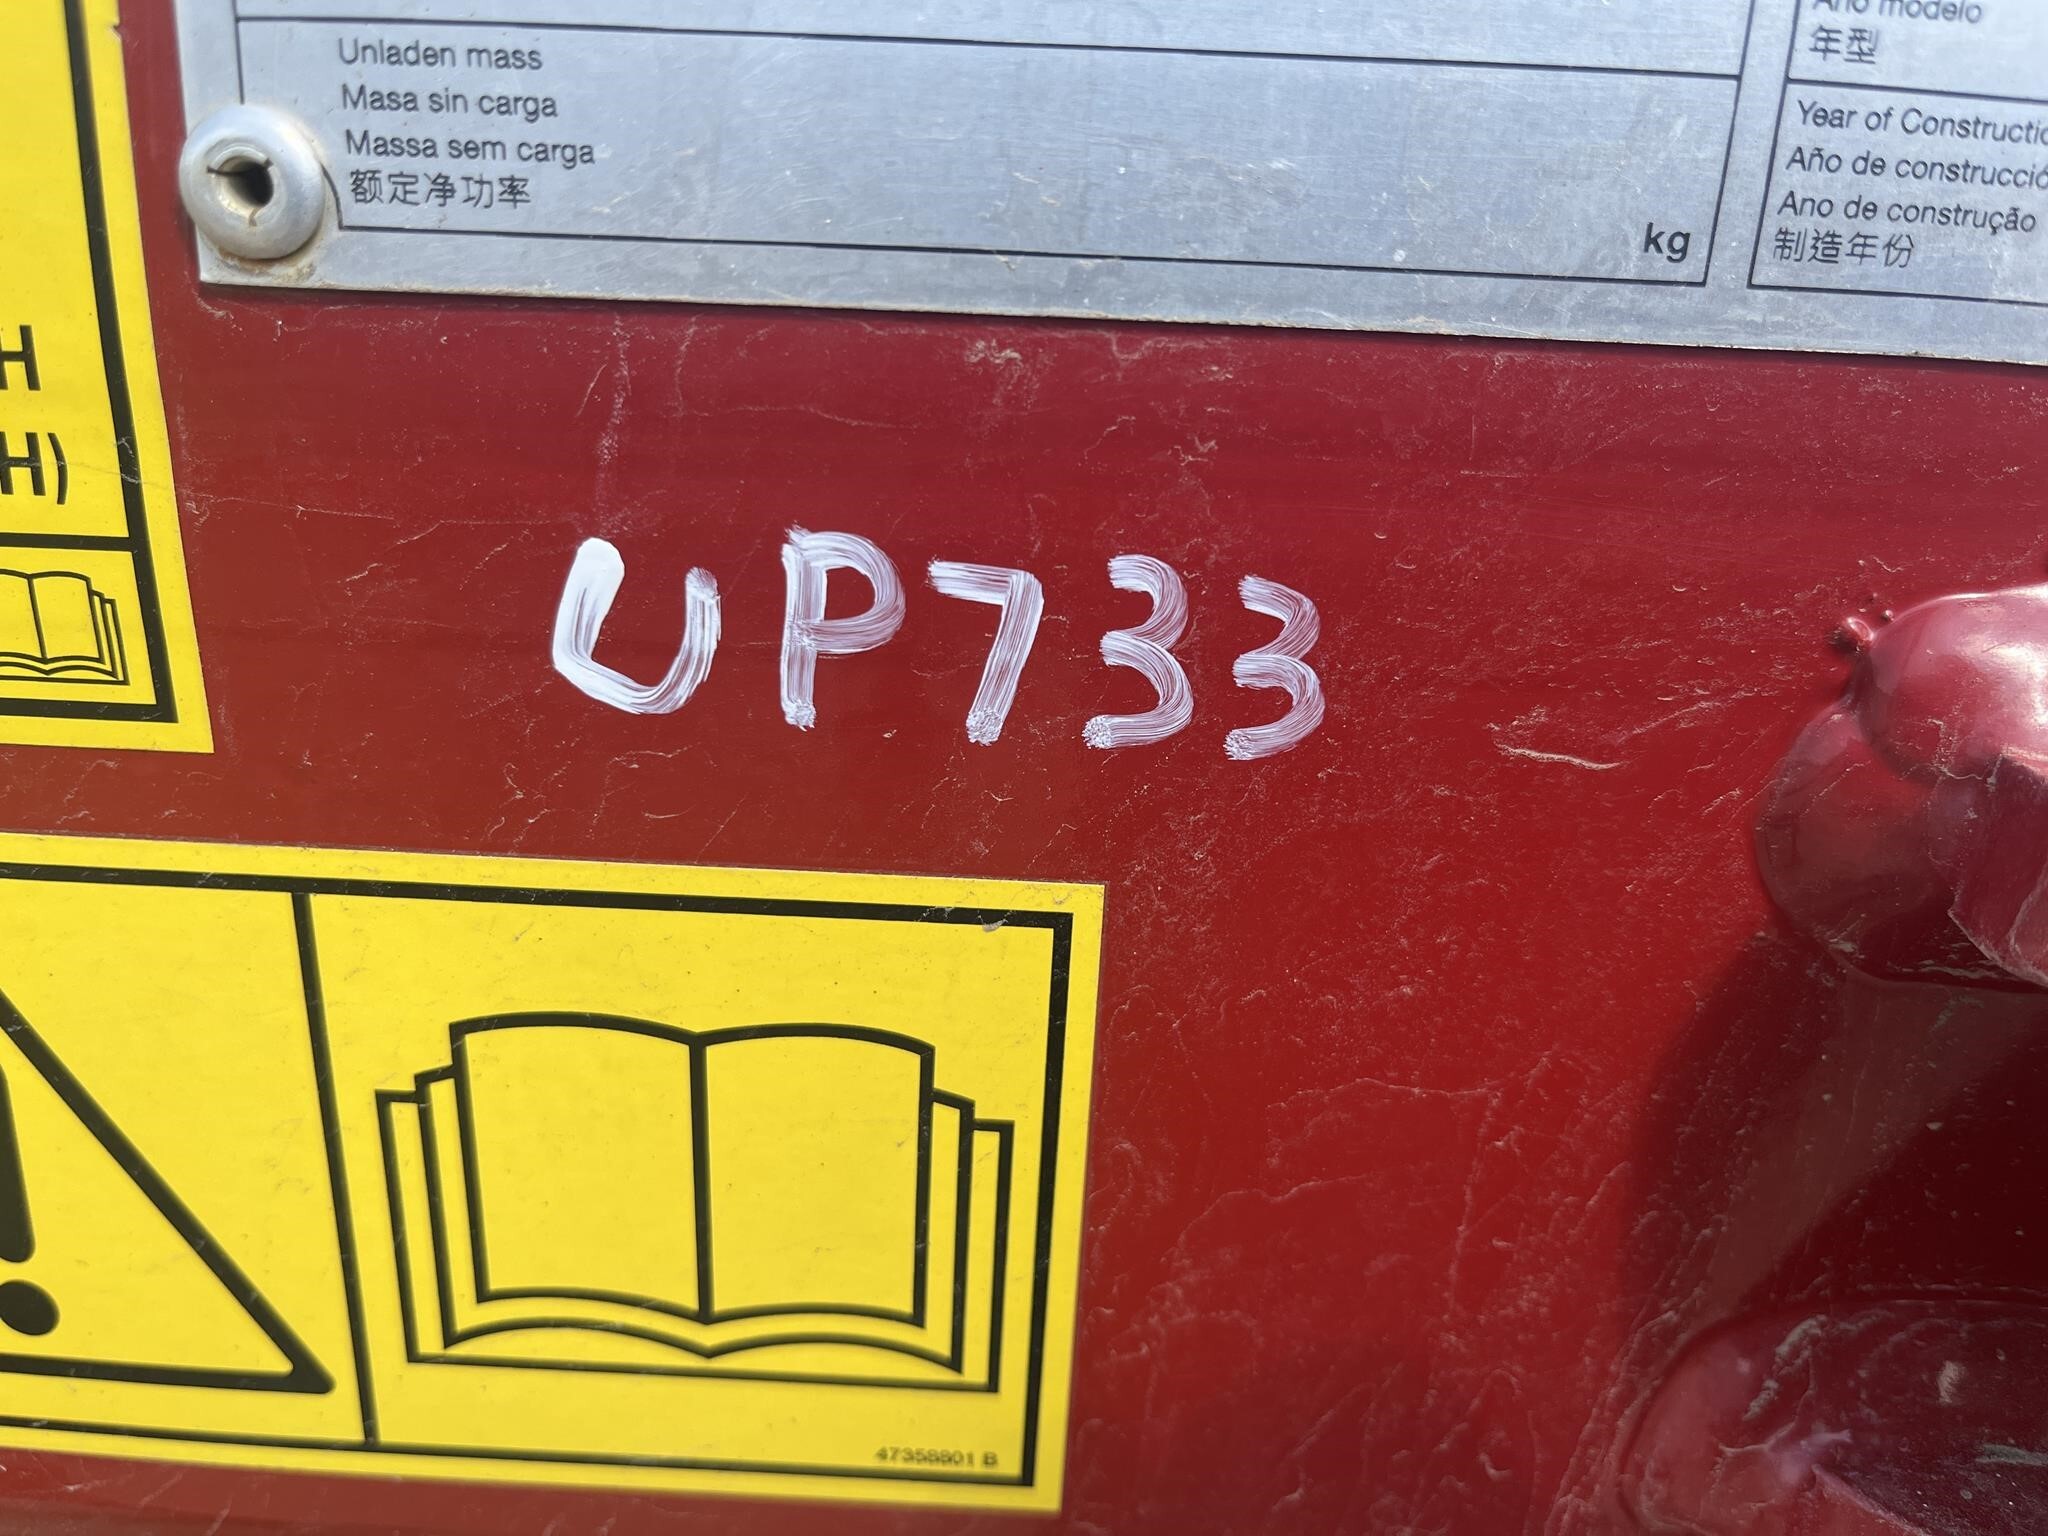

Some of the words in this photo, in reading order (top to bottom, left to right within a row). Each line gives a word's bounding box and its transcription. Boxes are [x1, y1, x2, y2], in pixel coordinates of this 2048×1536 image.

[1878, 0, 1983, 24] modelo
[338, 38, 457, 67] Unladen
[466, 50, 543, 70] mass
[1809, 25, 1879, 64] 年型
[341, 83, 419, 112] Masa
[428, 88, 469, 113] sin
[478, 95, 558, 123] carga
[1798, 100, 1857, 129] Year
[1864, 106, 1894, 132] of
[345, 128, 439, 158] Massa
[447, 139, 507, 161] sem
[517, 142, 595, 170] carga
[1786, 147, 1842, 174] Año
[1851, 151, 1886, 177] de
[350, 169, 531, 209] 额定净功率
[1777, 190, 1834, 217] Ano
[1843, 195, 1878, 221] de
[1887, 203, 2036, 235] construção
[1643, 222, 1691, 263] kg
[1773, 227, 1915, 268] 制造年份
[551, 526, 1326, 761] UP733
[982, 1451, 999, 1467] B
